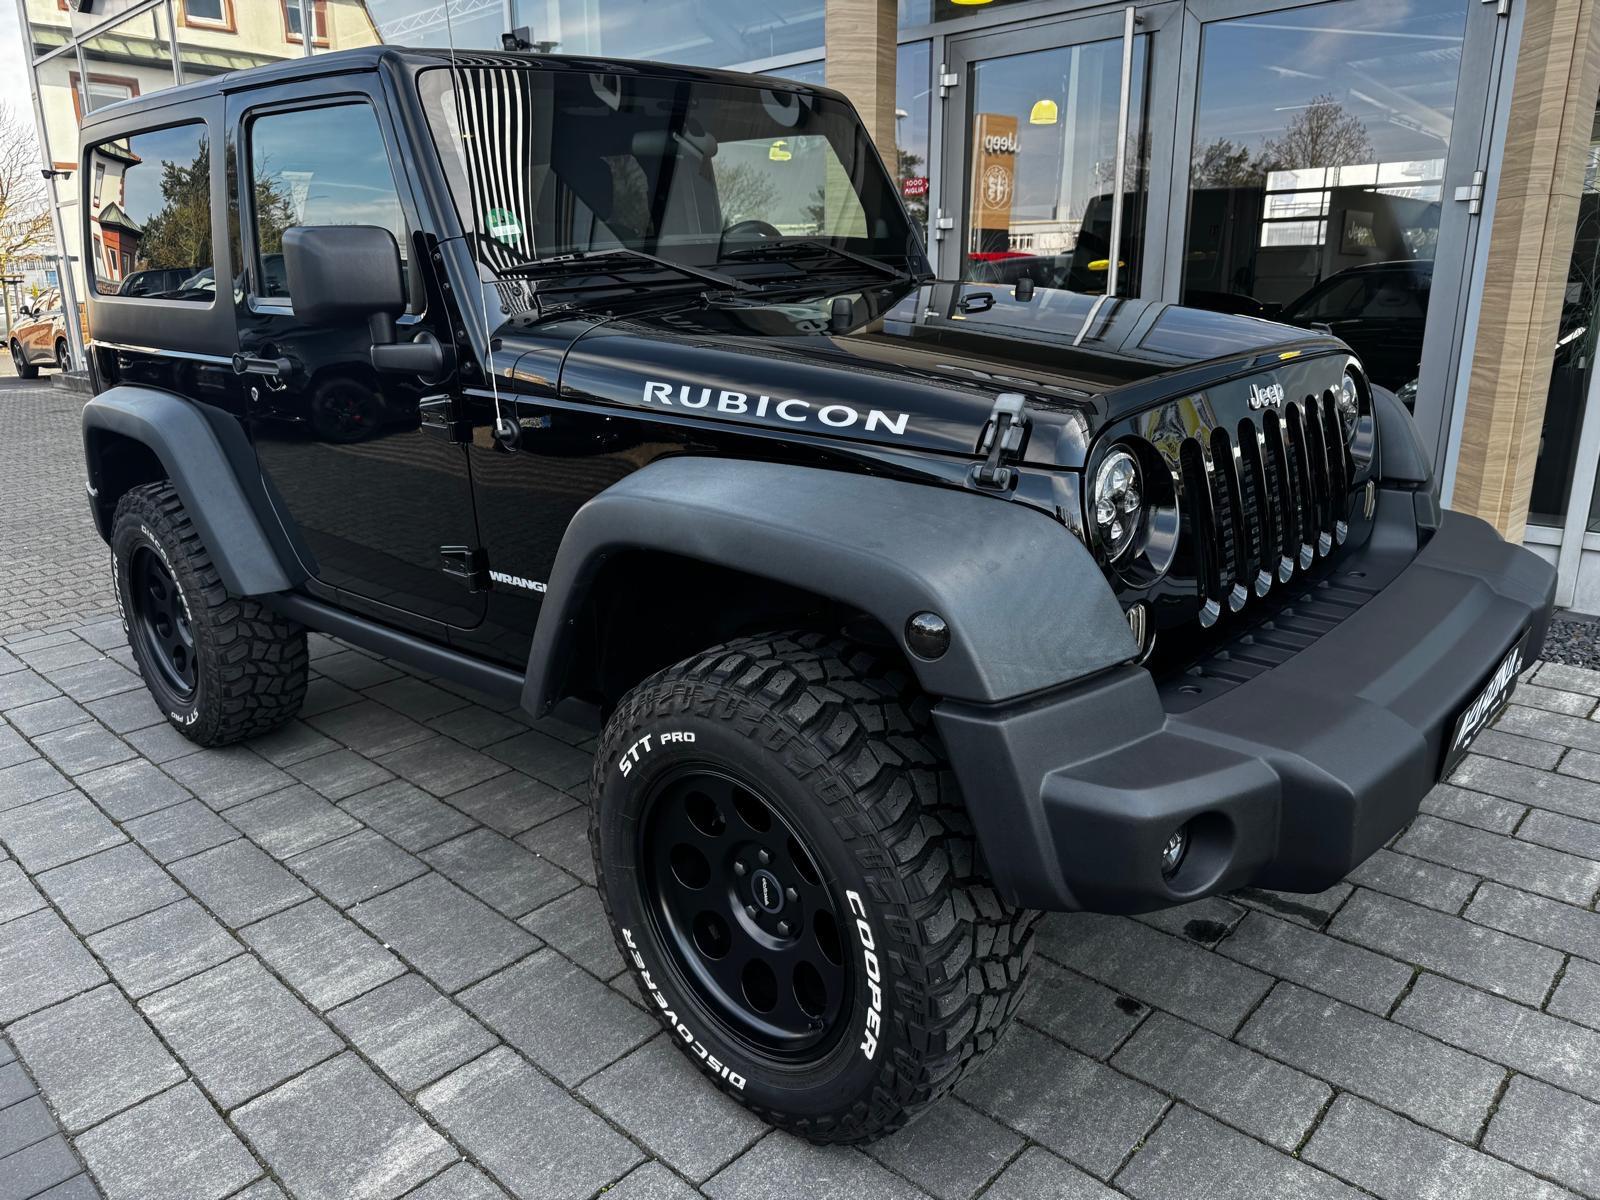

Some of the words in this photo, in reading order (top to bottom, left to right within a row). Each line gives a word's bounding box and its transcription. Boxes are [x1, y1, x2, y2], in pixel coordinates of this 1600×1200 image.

[643, 381, 910, 435] RUBICON
[1249, 383, 1284, 409] Jeep
[170, 711, 184, 723] PRO
[186, 707, 199, 726] STT
[619, 734, 653, 777] STT
[660, 731, 696, 746] PRO
[845, 889, 882, 1061] COOPER
[621, 928, 747, 1091] DISCOVERER
